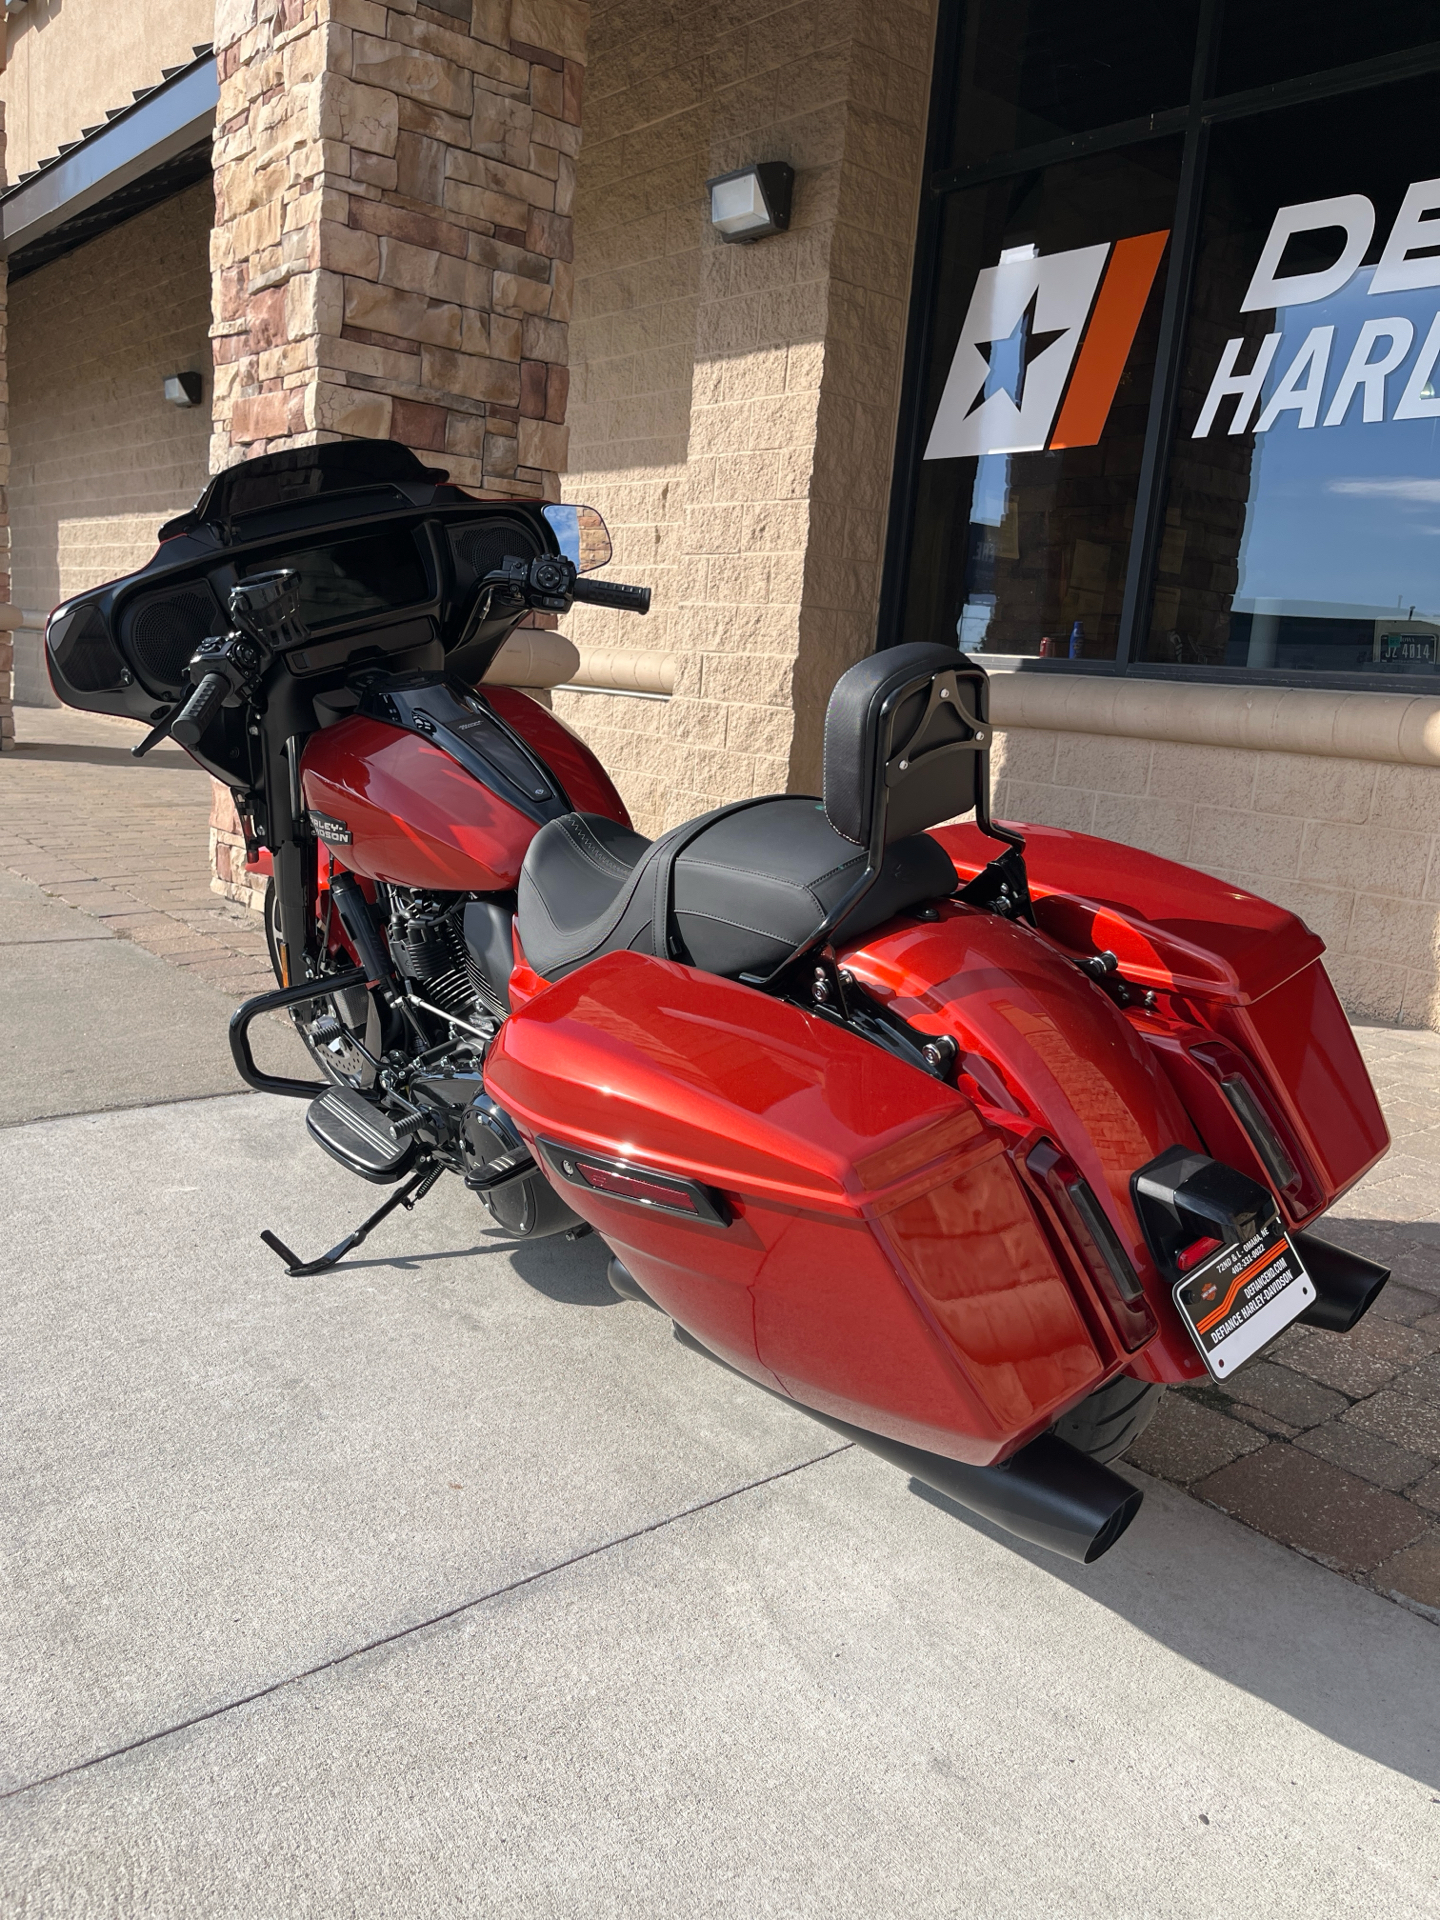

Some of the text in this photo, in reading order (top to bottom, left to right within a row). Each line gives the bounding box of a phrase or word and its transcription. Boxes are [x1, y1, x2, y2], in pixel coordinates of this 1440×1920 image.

[1402, 644, 1430, 659] 4014
[1216, 1257, 1232, 1274] 72ND
[1231, 1254, 1238, 1262] &
[1236, 1250, 1242, 1258] L
[1243, 1233, 1264, 1252] OMAHA,
[1260, 1227, 1270, 1238] NE
[1231, 1243, 1266, 1275] 402-331-0022
[1244, 1257, 1288, 1299] DEFIANCEHD.COM
[1210, 1311, 1244, 1344] DEFIANCE
[1240, 1268, 1294, 1319] HARLEY-DAVIDSON
